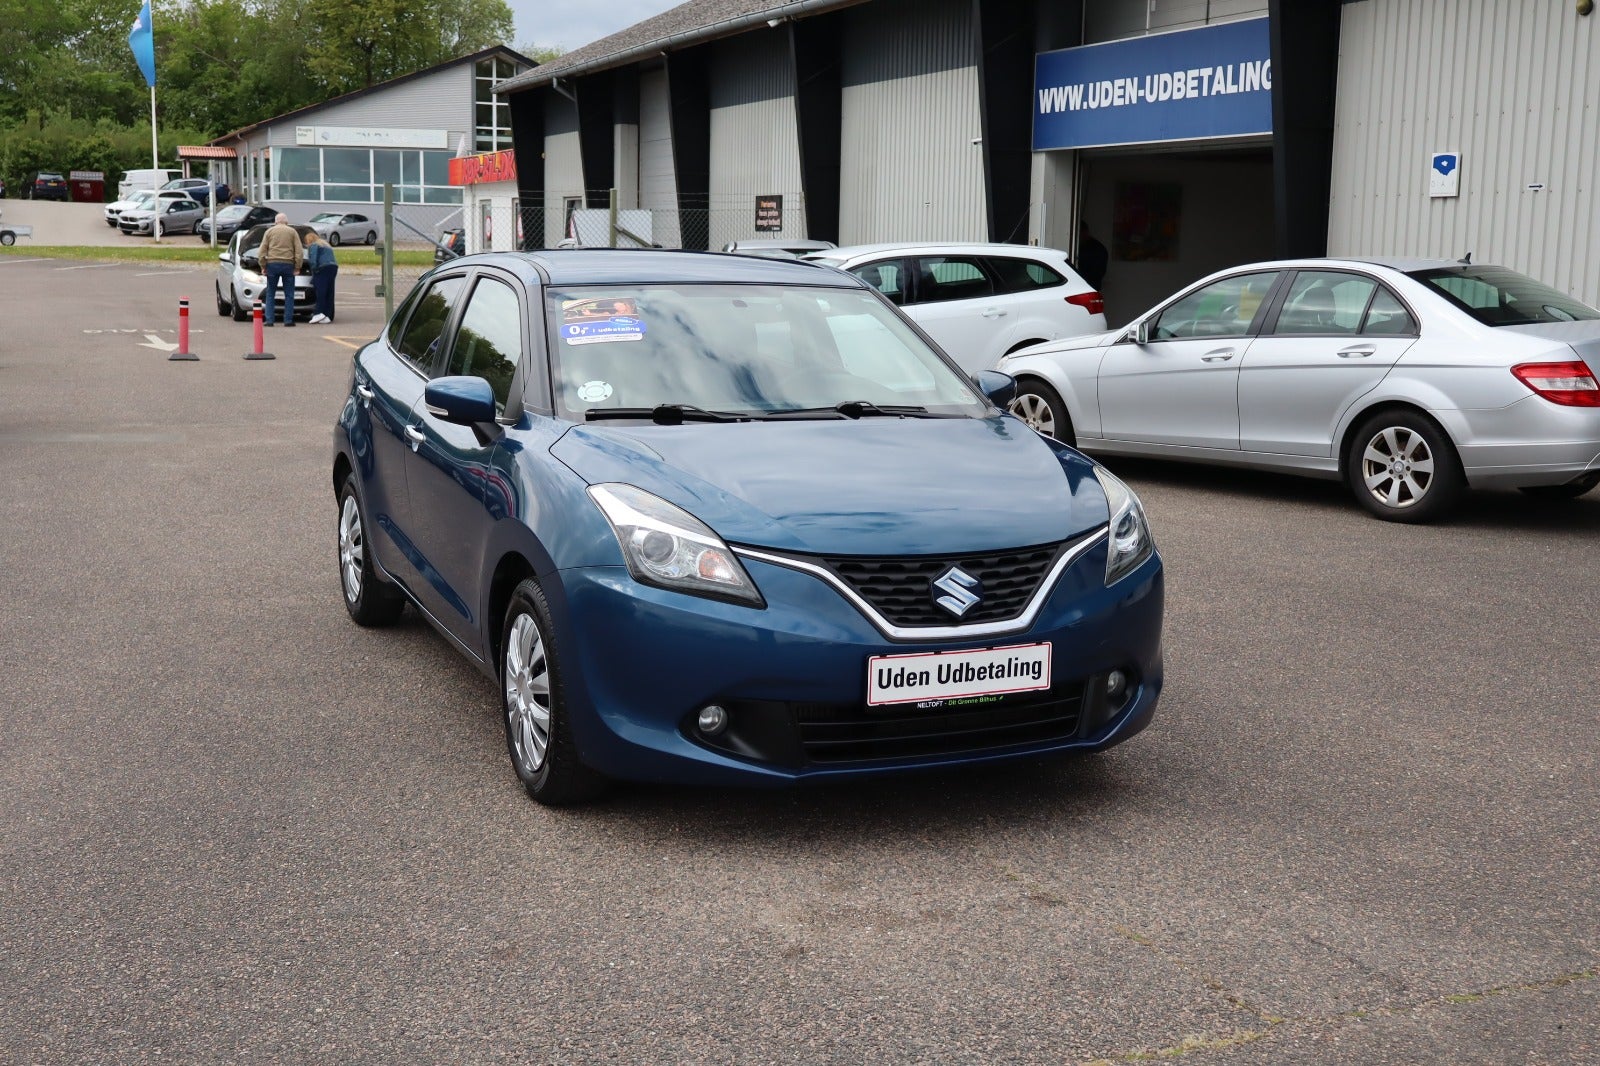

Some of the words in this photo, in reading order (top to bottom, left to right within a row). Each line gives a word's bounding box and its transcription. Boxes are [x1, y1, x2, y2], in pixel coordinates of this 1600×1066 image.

[598, 326, 641, 334] udbetaling
[878, 666, 930, 690] Uden
[937, 656, 1043, 685] Udbetaling
[917, 701, 944, 709] NELTOFT
